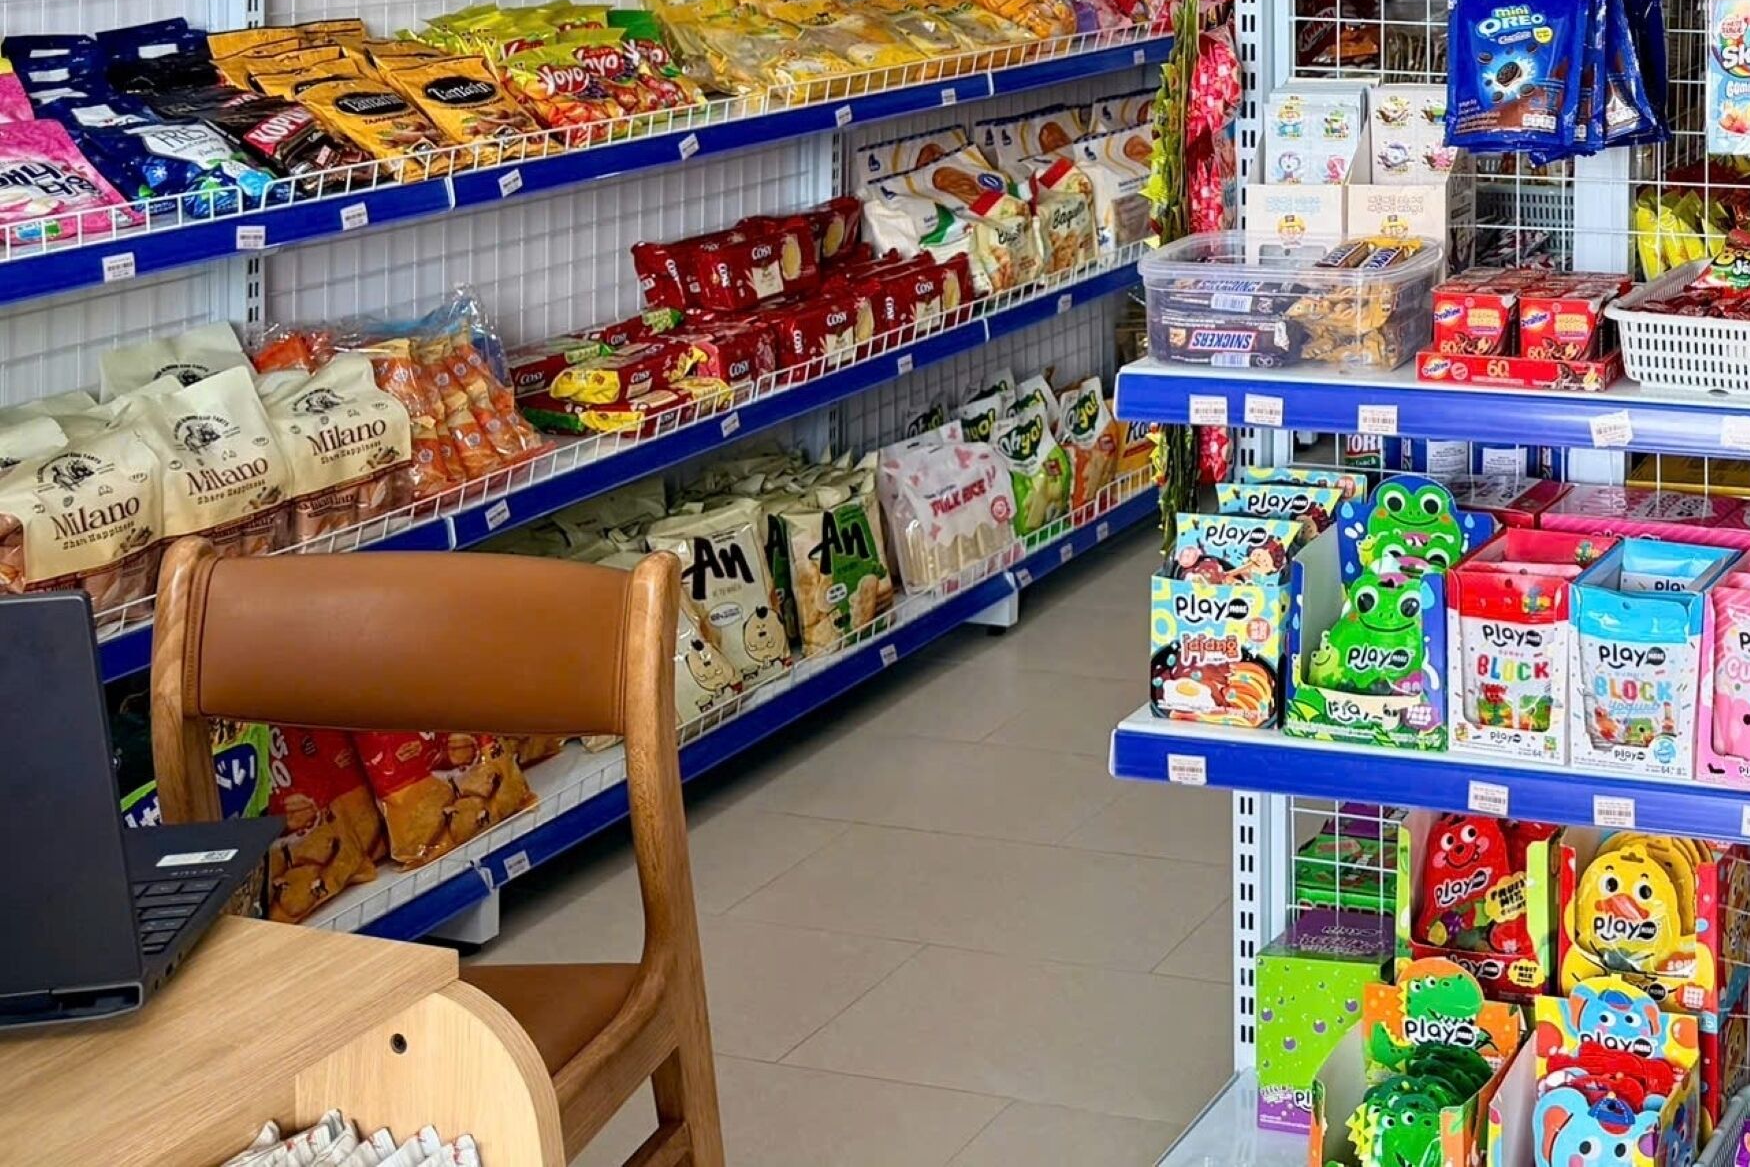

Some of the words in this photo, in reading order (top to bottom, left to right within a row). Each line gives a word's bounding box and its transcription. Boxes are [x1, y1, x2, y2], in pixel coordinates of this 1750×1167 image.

[1477, 13, 1545, 37] OREO
[1494, 4, 1530, 19] mini
[307, 416, 387, 457] Milano
[186, 454, 270, 498] Milano
[52, 493, 141, 542] Milano
[808, 509, 871, 576] An
[682, 536, 756, 601] An
[1477, 653, 1550, 682] BLOCK
[1593, 674, 1673, 703] BLOCK
